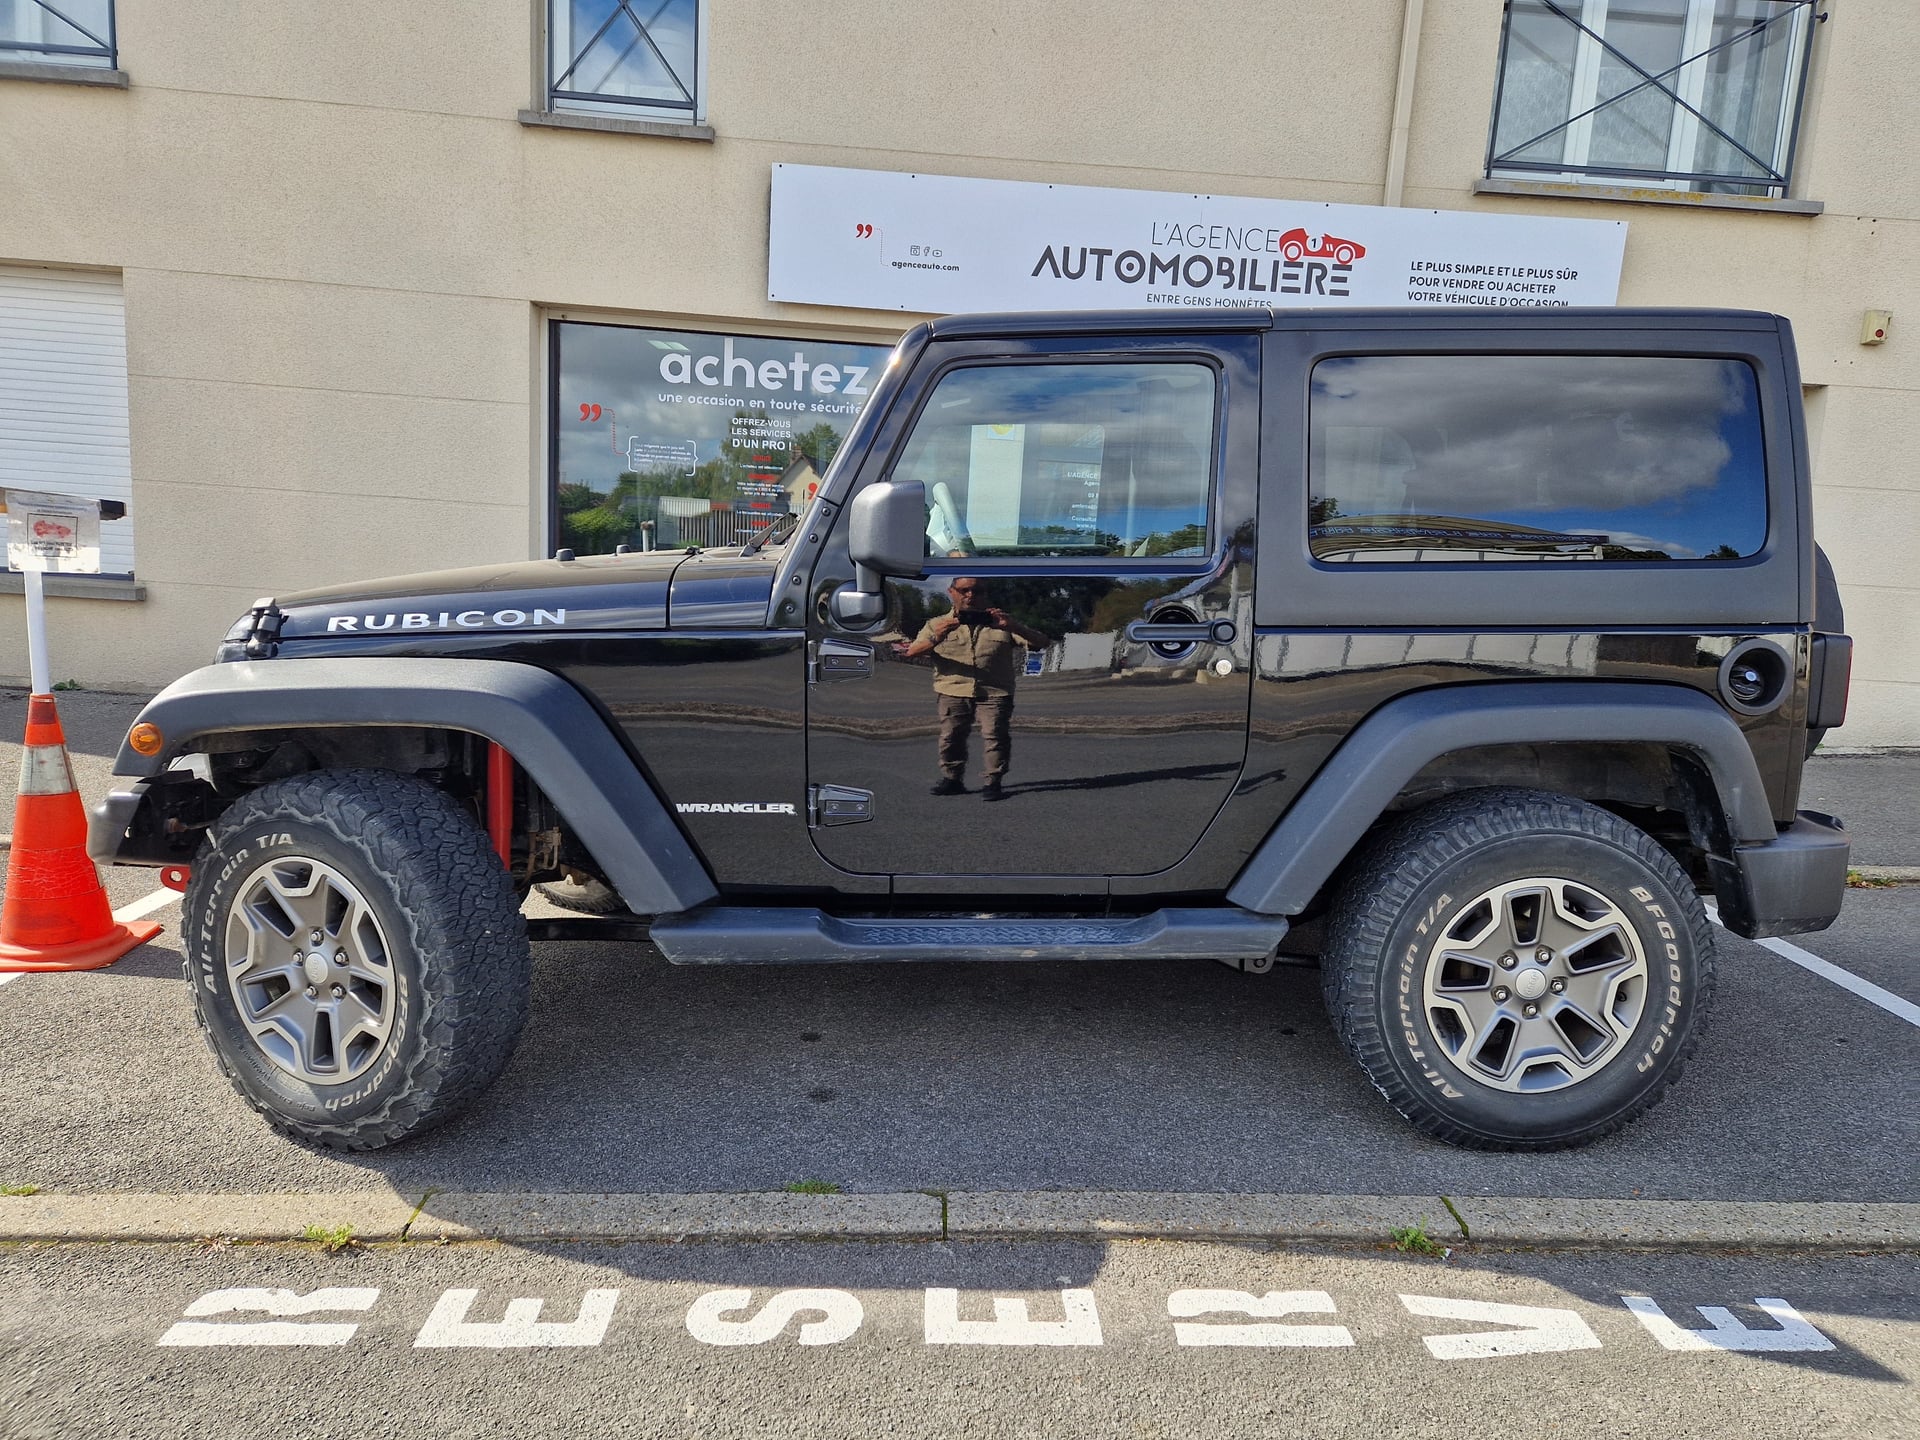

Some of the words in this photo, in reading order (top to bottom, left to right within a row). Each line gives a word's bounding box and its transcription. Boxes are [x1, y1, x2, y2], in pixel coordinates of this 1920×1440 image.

[1151, 222, 1280, 252] L'AGENCE
[1311, 237, 1317, 248] 1
[891, 260, 960, 272] agenceauto.com
[1411, 261, 1423, 271] LE
[1426, 262, 1452, 273] PLUS
[1455, 264, 1495, 276] SIMPLE
[1497, 266, 1510, 276] ET
[1512, 267, 1525, 278] LE
[1527, 268, 1554, 279] PLUS
[1556, 267, 1578, 281] SÛR
[1409, 276, 1440, 287] POUR
[1443, 278, 1485, 290] VENDRE
[1487, 281, 1504, 291] OU
[1506, 282, 1556, 294] ACHETER
[1147, 294, 1180, 305] ENTRE
[1183, 296, 1211, 307] GENS
[1215, 298, 1272, 309] HONNÊTES
[1408, 291, 1443, 302] VOTRE
[1445, 290, 1497, 306] VÉHICULE
[659, 337, 870, 396] achetez
[658, 393, 683, 403] une
[688, 393, 745, 408] occasion
[749, 399, 766, 409] en
[770, 398, 806, 412] toute
[810, 400, 863, 415] sécurité
[731, 417, 791, 428] OFFREZ-VOUS
[731, 427, 748, 436] LES
[749, 428, 791, 439] SERVICES
[732, 438, 759, 449] D'UN
[762, 440, 786, 451] PRO
[326, 608, 566, 632] RUBICON
[675, 803, 796, 815] WRANGLER
[200, 848, 249, 995] All-Terrain
[255, 832, 295, 849] T/A
[1415, 893, 1453, 937] T/A
[1629, 886, 1682, 1075] BFGoodrich
[1399, 942, 1464, 1099] All-Terrain
[325, 973, 409, 1112] BFGoodrich
